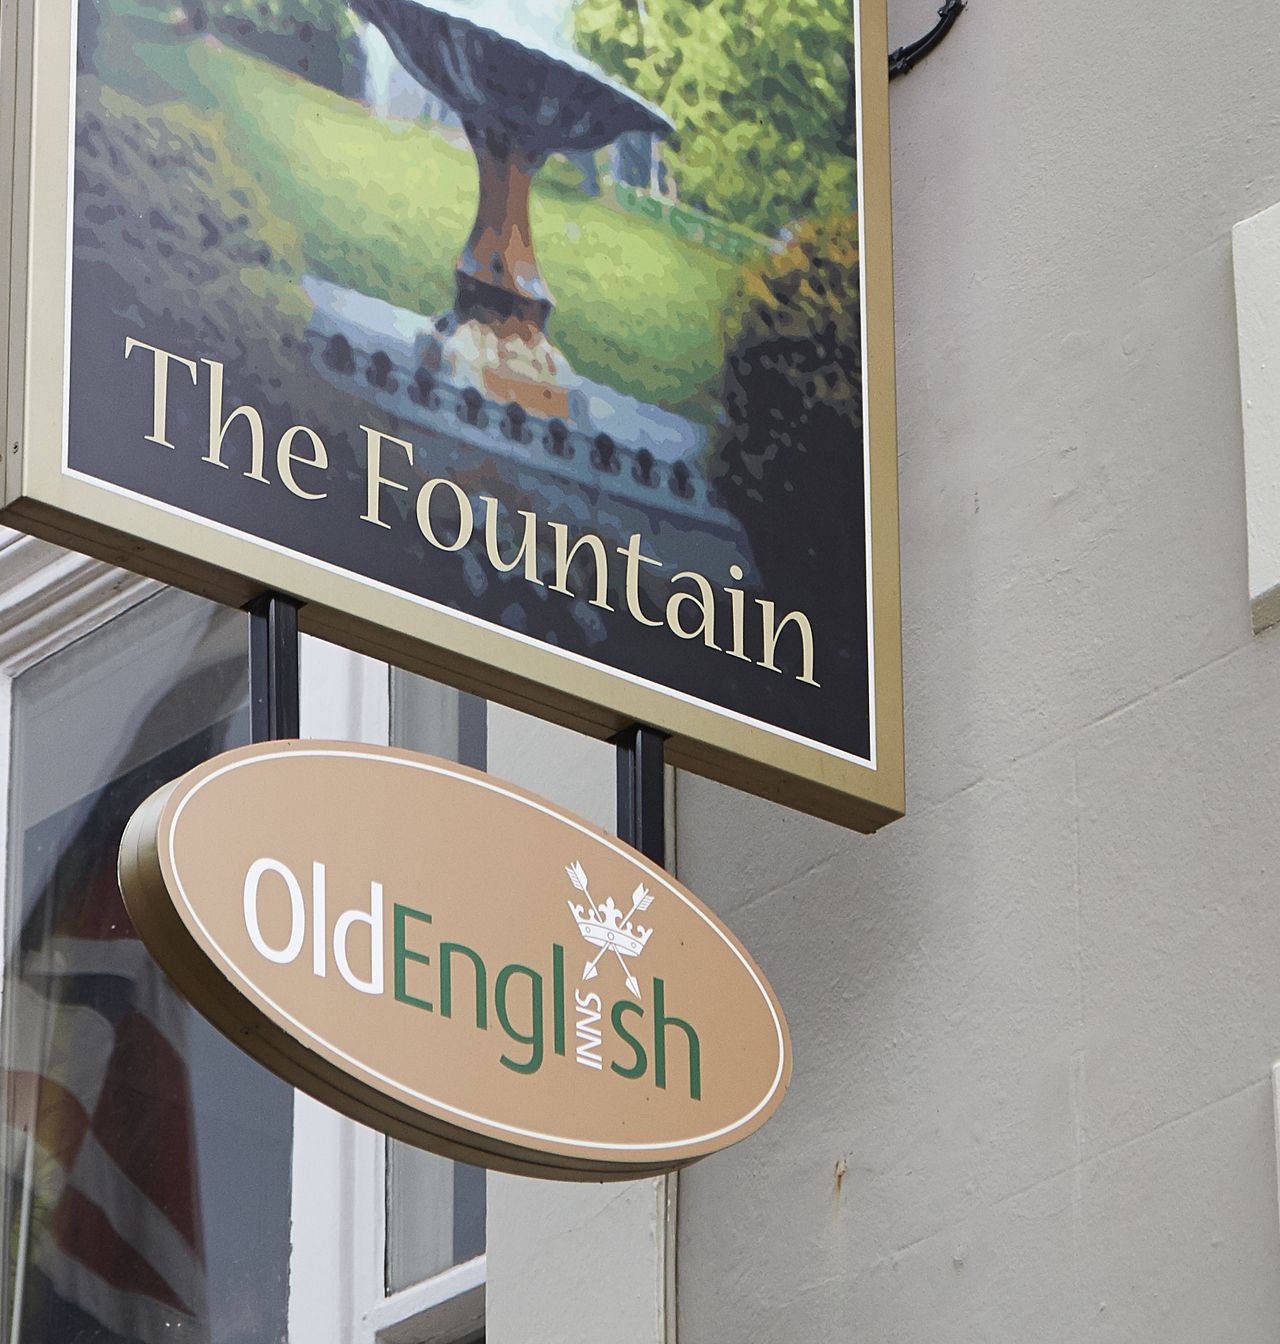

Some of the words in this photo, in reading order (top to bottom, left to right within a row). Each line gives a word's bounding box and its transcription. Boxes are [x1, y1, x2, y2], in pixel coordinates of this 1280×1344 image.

[123, 336, 329, 501] The
[358, 424, 821, 689] Fountain
[575, 988, 603, 1071] INNS
